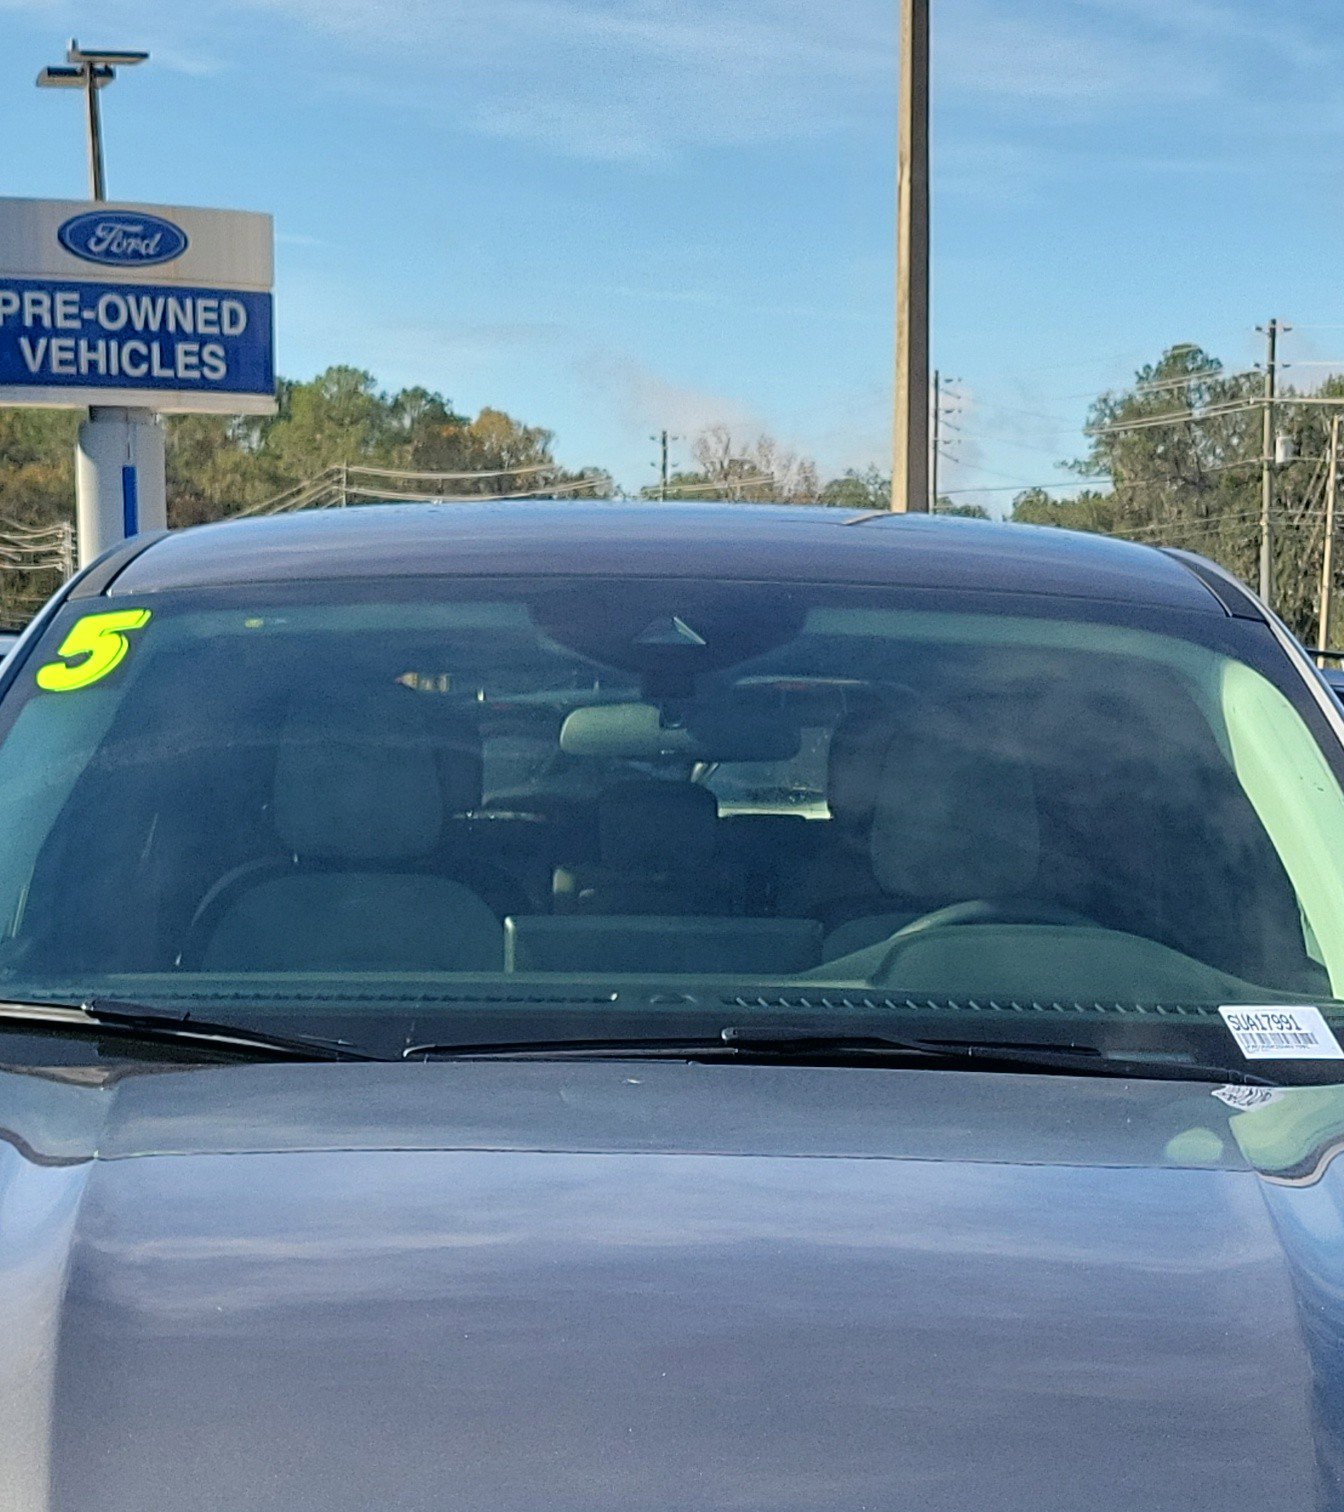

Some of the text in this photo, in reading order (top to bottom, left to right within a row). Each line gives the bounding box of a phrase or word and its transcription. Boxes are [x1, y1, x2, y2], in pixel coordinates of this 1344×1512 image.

[87, 221, 163, 258] Ford
[18, 336, 228, 381] VEHICLES
[36, 608, 152, 692] 5
[1227, 1013, 1303, 1032] SUA17991
